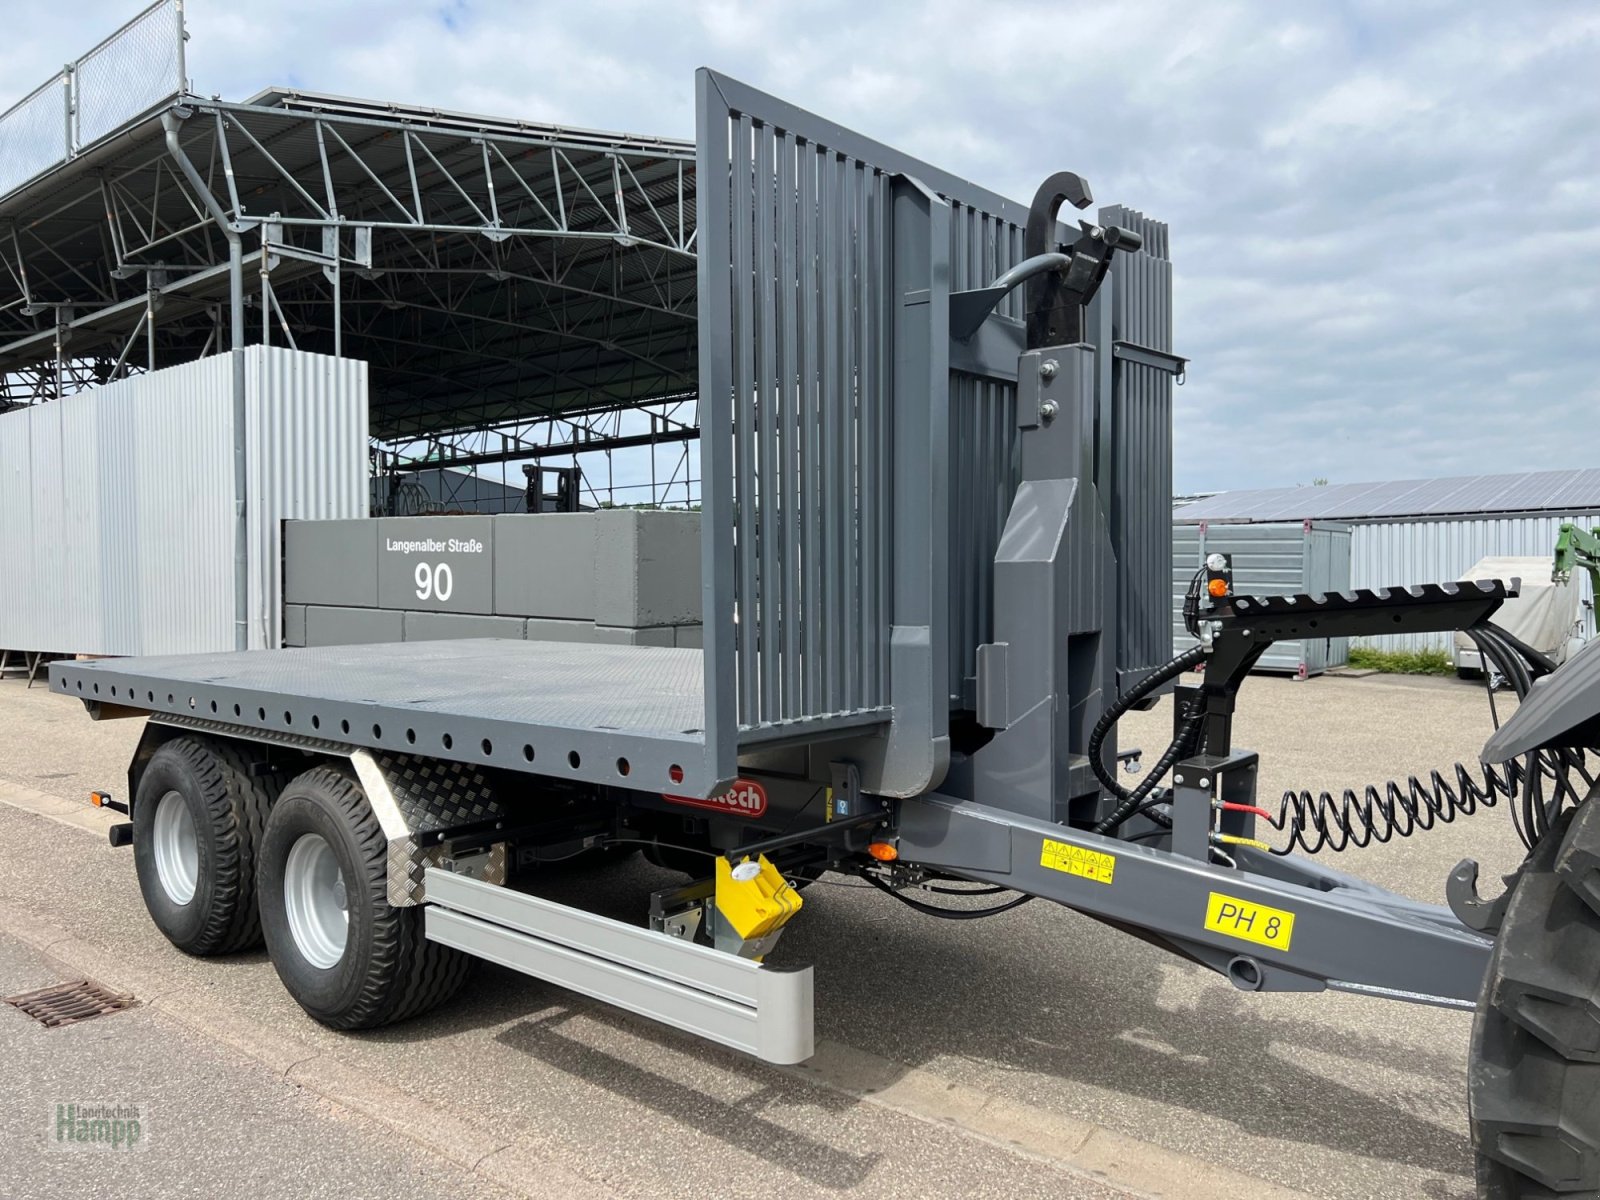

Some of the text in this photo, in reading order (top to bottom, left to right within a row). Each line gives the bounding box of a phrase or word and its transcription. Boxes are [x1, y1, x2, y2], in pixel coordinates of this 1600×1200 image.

[386, 538, 483, 554] Langenalber Straße
[414, 562, 453, 602] 90
[1216, 902, 1281, 939] PH 8
